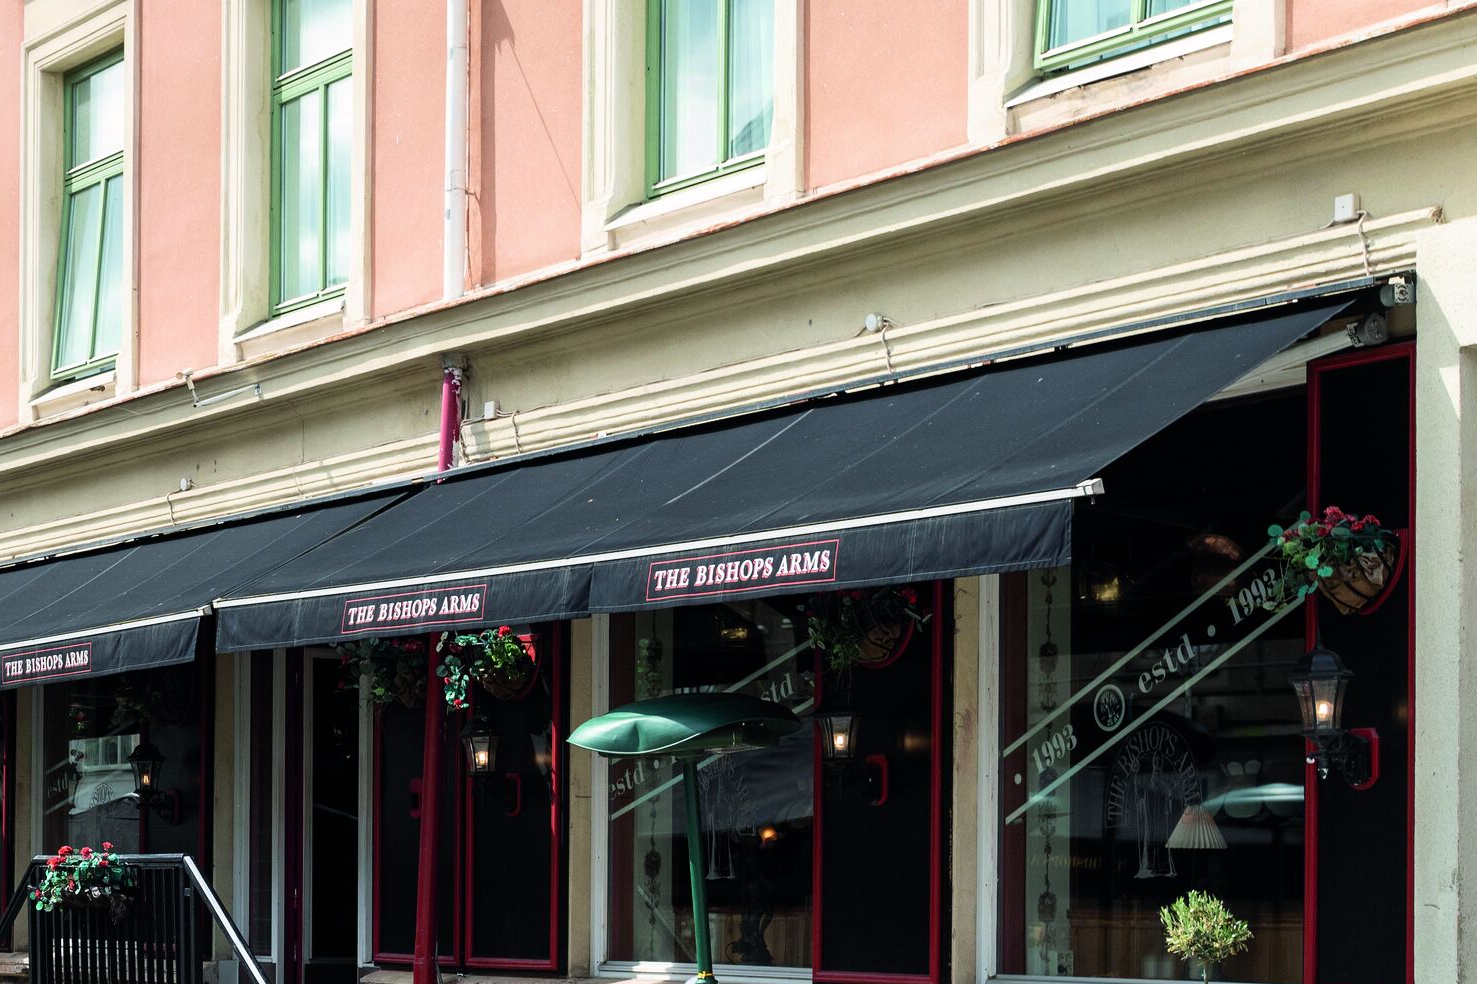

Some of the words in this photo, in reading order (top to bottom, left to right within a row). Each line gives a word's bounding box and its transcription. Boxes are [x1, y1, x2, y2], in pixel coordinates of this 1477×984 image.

[654, 568, 690, 591] THE
[694, 557, 774, 586] BISHOPS
[776, 550, 830, 576] ARMS
[348, 605, 375, 625] THE
[377, 598, 437, 621] BISHOPS
[439, 593, 480, 615] ARMS
[5, 660, 23, 676] THE
[25, 654, 63, 674] BISHOPS
[65, 650, 89, 668] ARMS
[1032, 724, 1078, 775] 1993
[1137, 633, 1196, 693] estd
[1226, 568, 1276, 626] 1993
